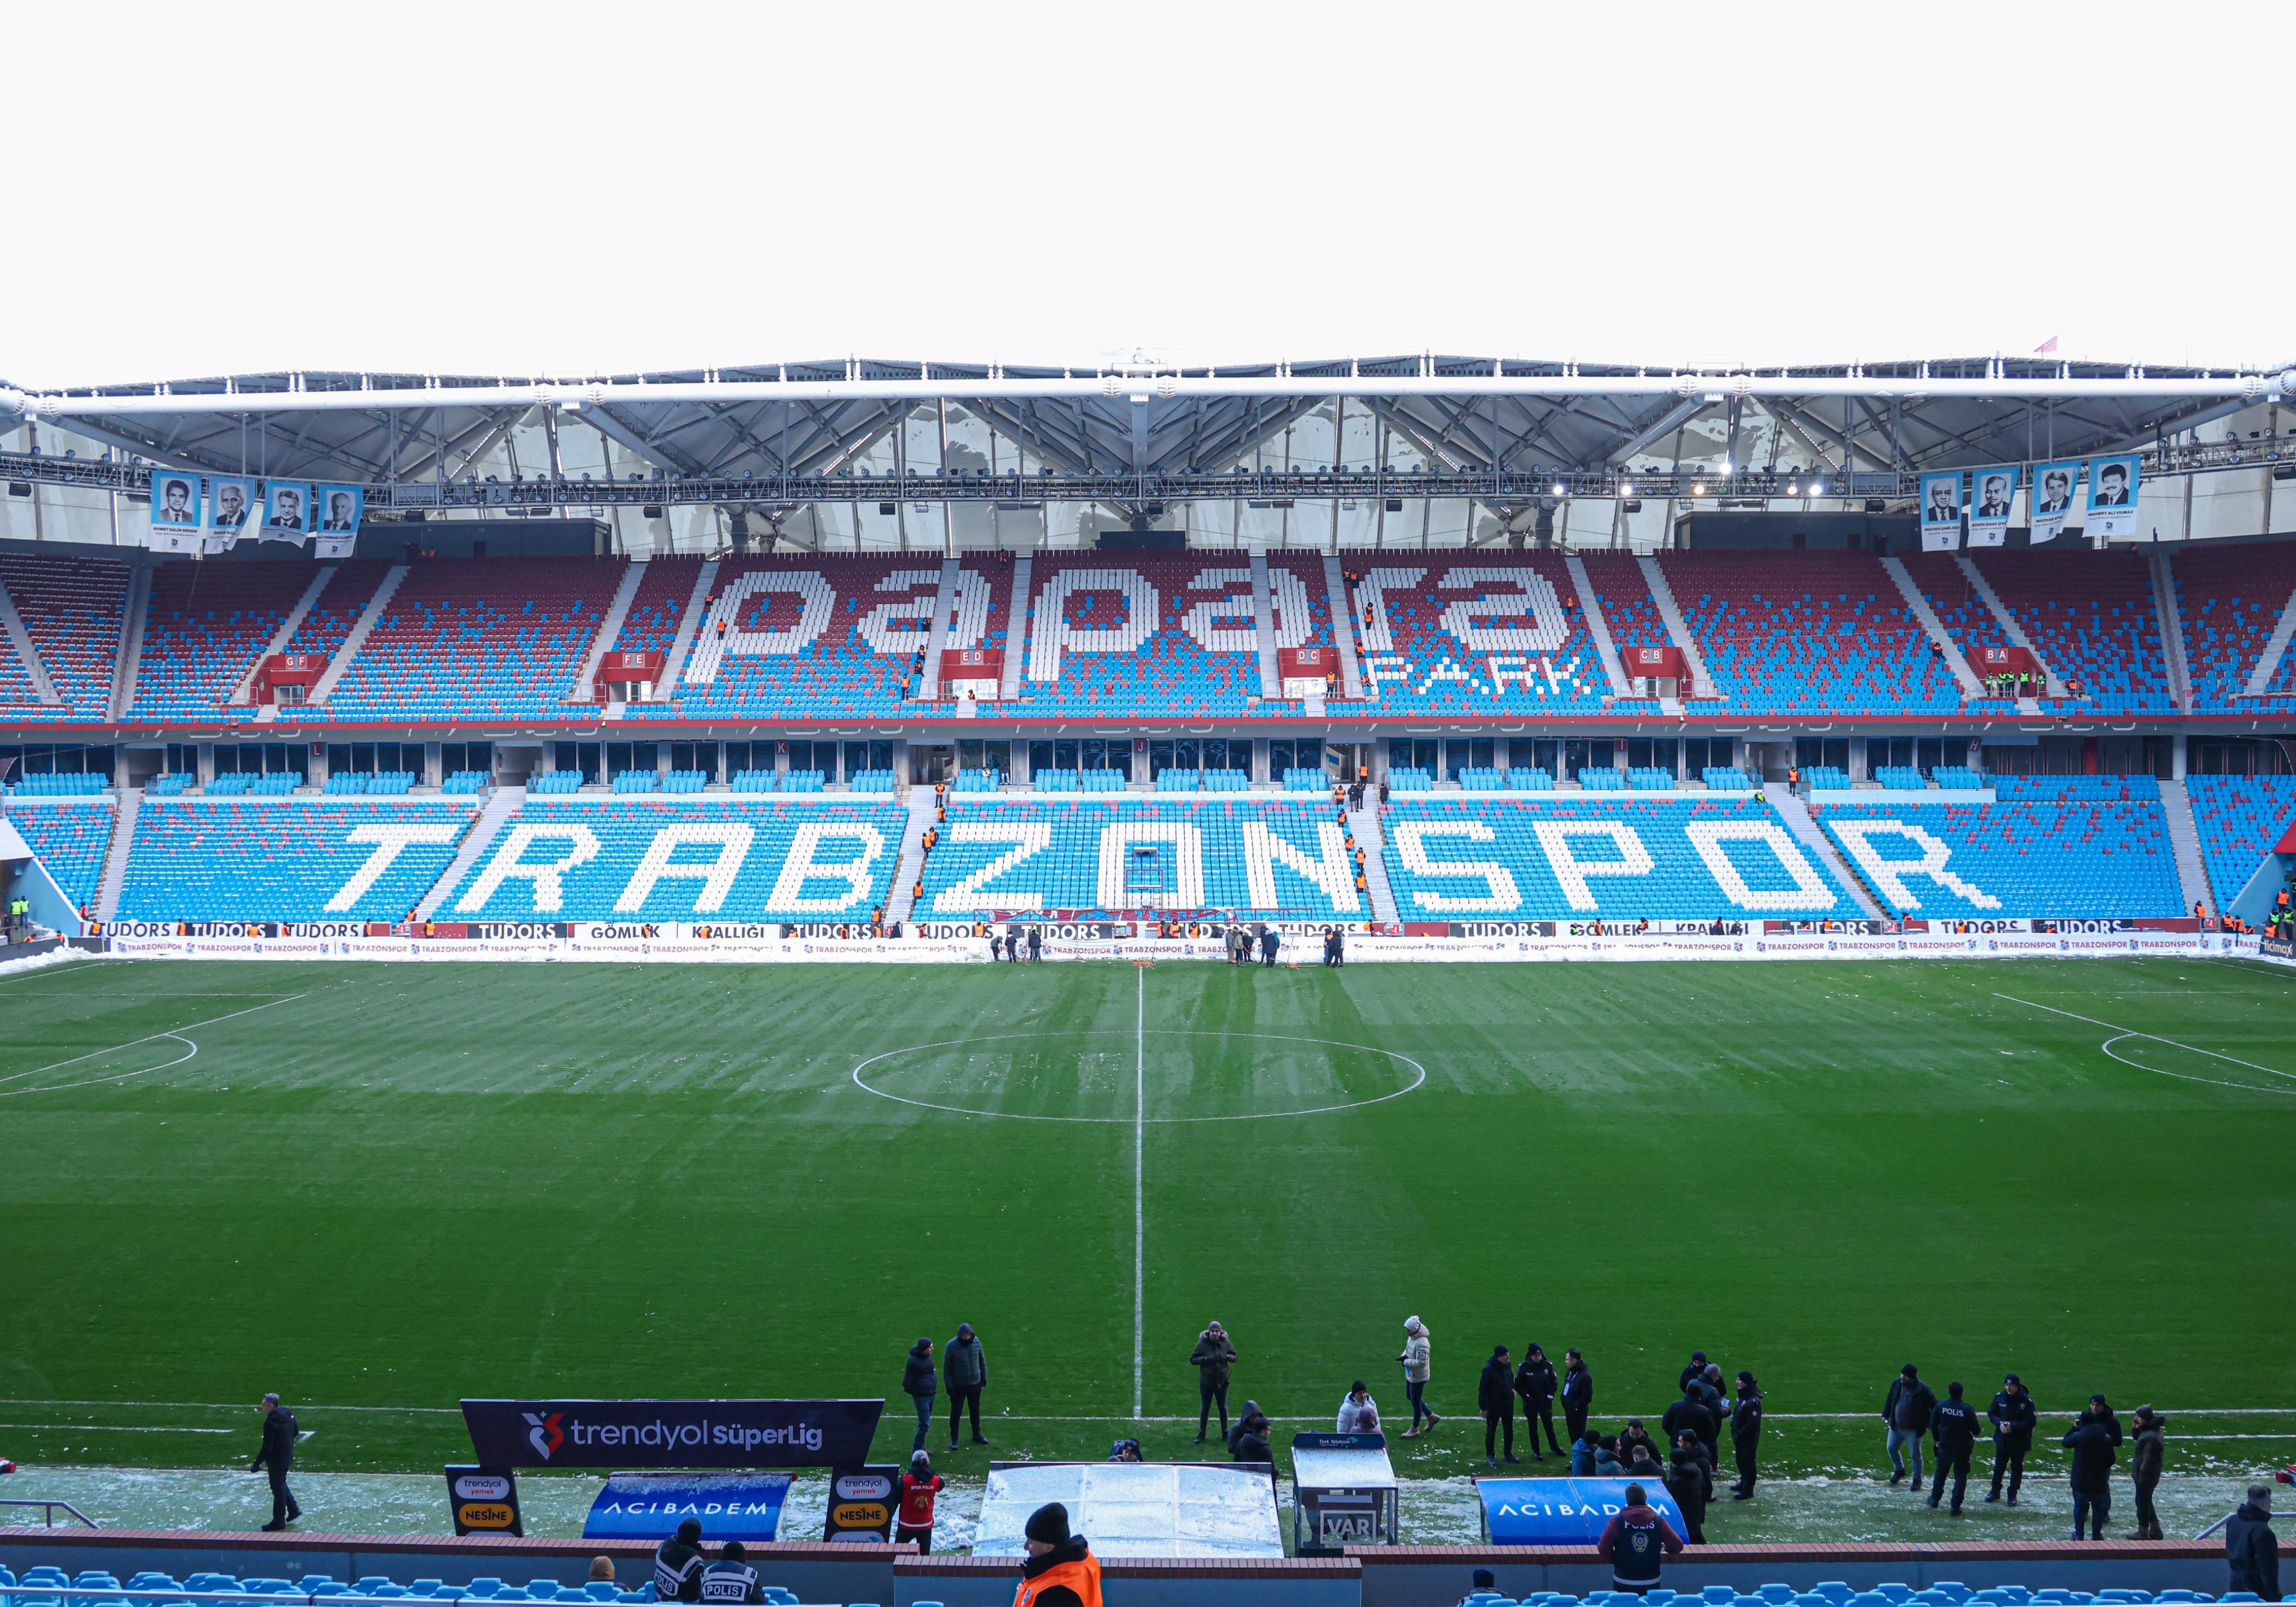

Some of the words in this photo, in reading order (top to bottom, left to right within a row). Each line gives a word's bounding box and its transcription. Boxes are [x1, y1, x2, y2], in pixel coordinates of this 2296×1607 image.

[625, 655, 630, 664] F
[637, 655, 642, 664] E
[962, 652, 969, 661] E
[974, 652, 981, 661] D
[1299, 651, 1305, 660] D
[1311, 651, 1317, 660] C
[1641, 650, 1647, 659] C
[1654, 650, 1660, 659] B
[1988, 650, 1994, 659] B
[1999, 650, 2006, 659] A
[286, 657, 293, 666] G
[299, 657, 304, 666] F
[314, 745, 320, 756] L
[778, 743, 785, 753] K
[1137, 742, 1144, 752] J
[1970, 739, 1979, 751] H
[322, 820, 2003, 912] TRABZONSPOR
[100, 923, 170, 937] UDORS
[479, 924, 556, 938] TUDORS
[1461, 923, 1542, 937] TUDORS
[2264, 939, 2293, 957] ticimax
[571, 1419, 708, 1450] trendyol
[712, 1423, 823, 1451] SüperLig
[464, 1479, 501, 1488] trendyol
[845, 1479, 882, 1488] trendyol
[603, 1502, 766, 1515] ACIBADEM
[1498, 1503, 1670, 1516] ACIBADM
[1327, 1518, 1370, 1535] VAR
